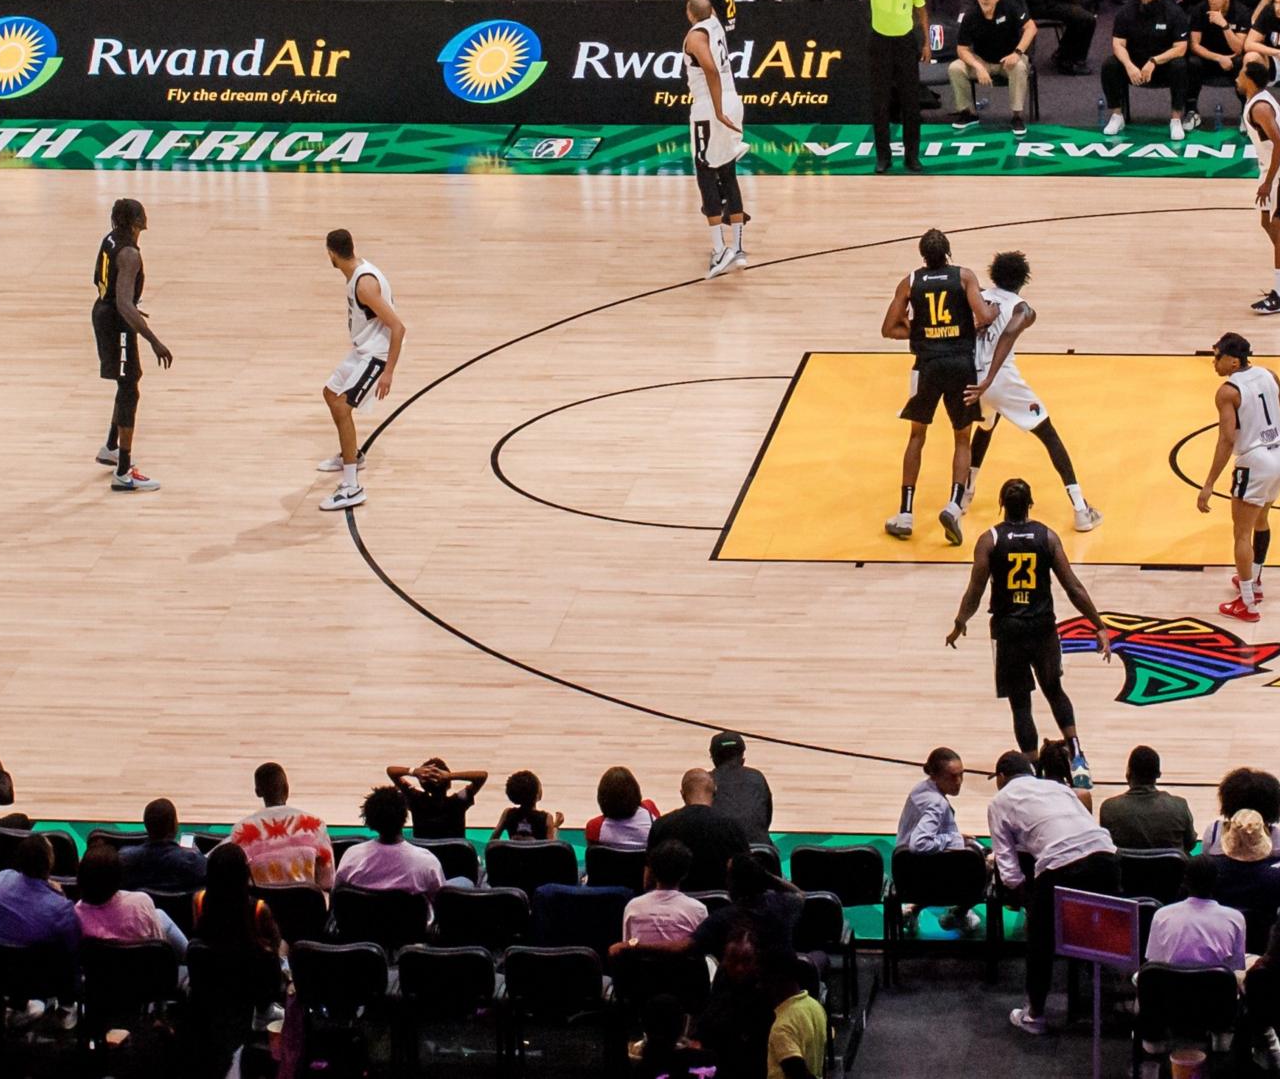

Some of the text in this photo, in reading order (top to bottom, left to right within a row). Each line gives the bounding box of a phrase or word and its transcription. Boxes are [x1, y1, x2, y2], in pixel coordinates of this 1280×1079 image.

[88, 38, 350, 77] RwandAir
[572, 40, 842, 79] RwadAir
[167, 87, 338, 104] Fly the dream of Africa
[654, 90, 677, 107] Fly
[760, 90, 778, 107] of
[778, 90, 829, 107] Africa
[96, 130, 369, 162] AFRICA
[803, 141, 985, 156] VISIT
[924, 290, 952, 326] 14
[1258, 392, 1273, 426] 1
[1007, 552, 1037, 590] 23
